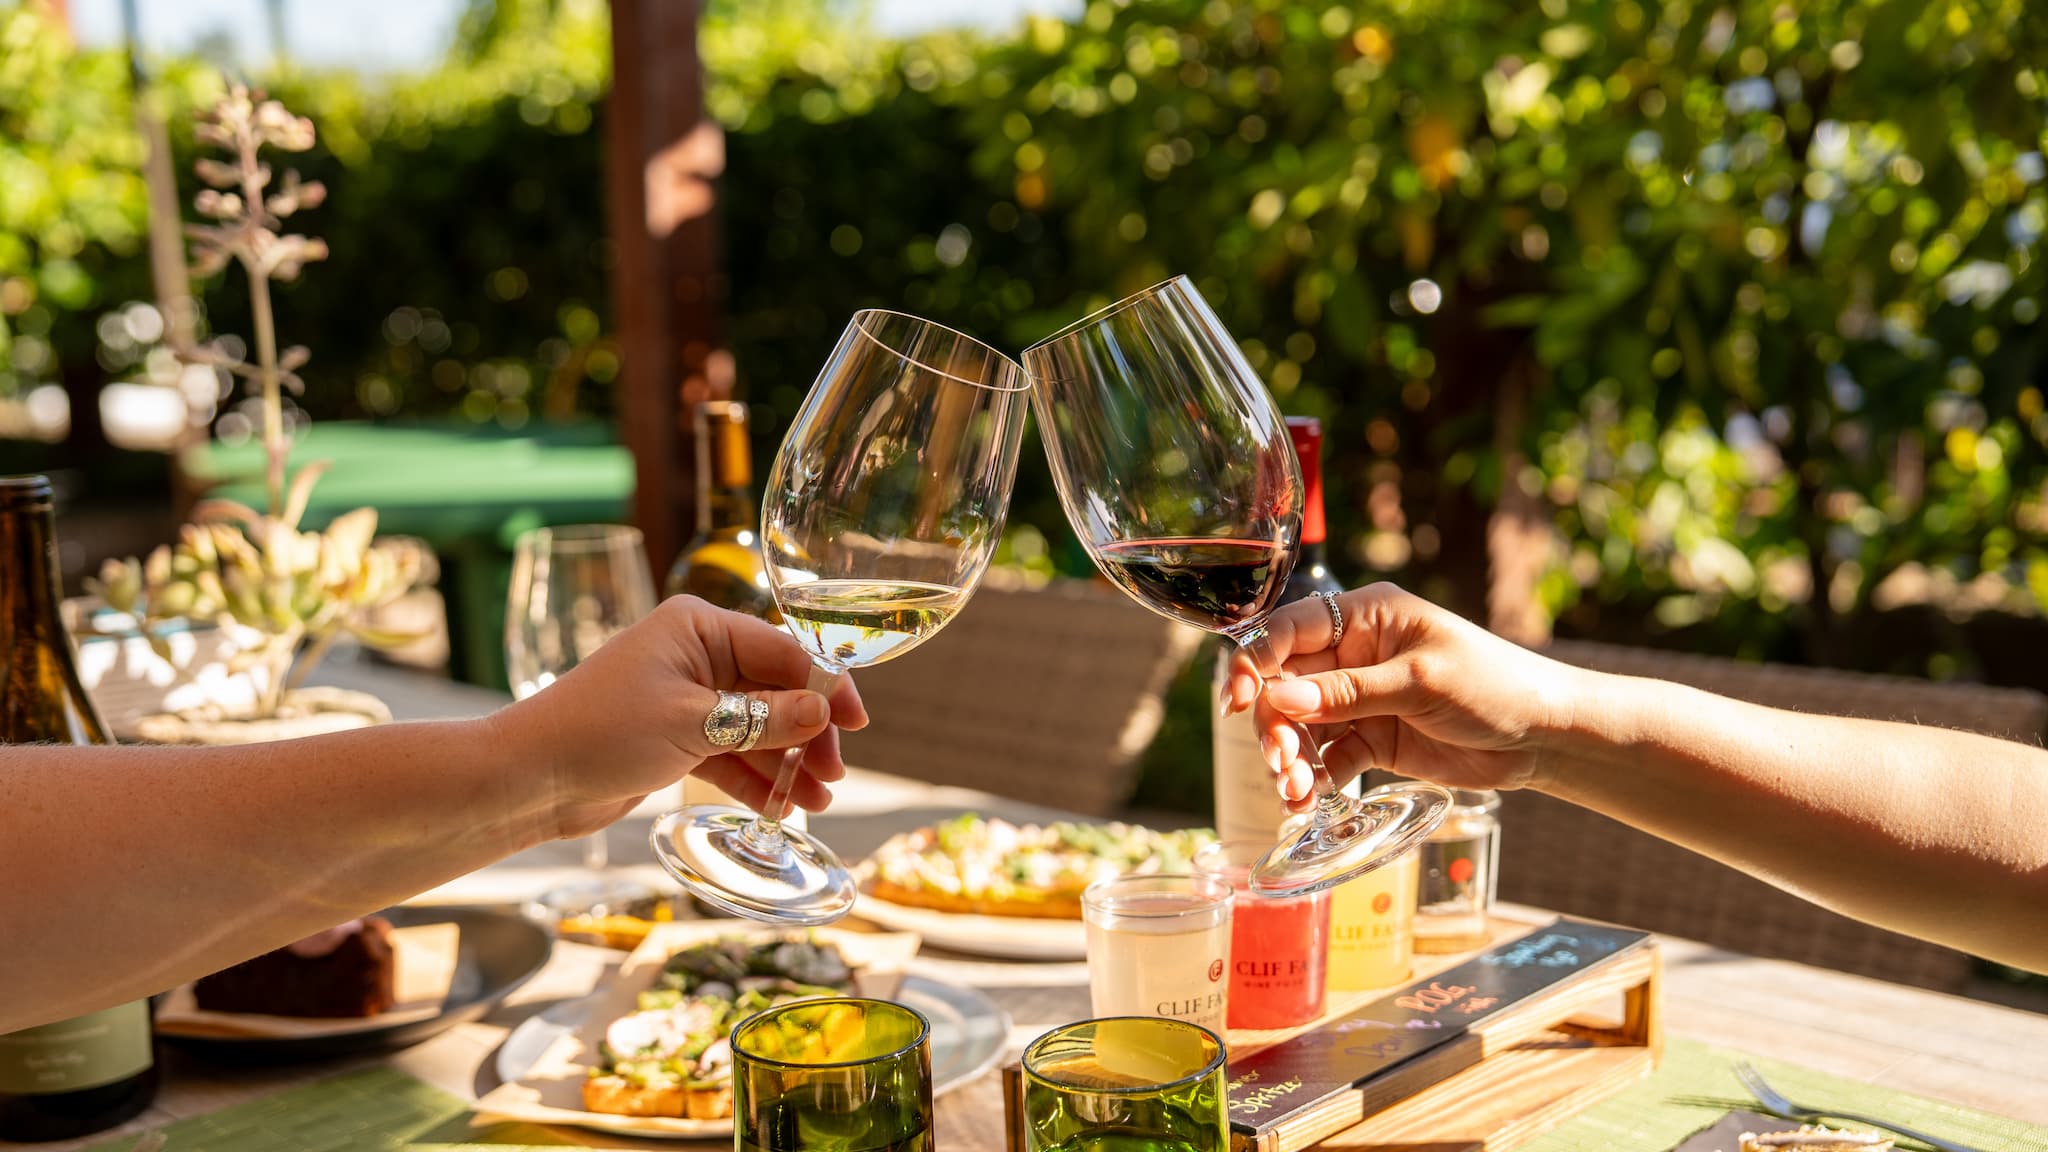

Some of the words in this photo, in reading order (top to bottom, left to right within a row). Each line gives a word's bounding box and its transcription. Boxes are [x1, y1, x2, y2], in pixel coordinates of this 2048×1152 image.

[1334, 924, 1365, 940] LIF
[1236, 961, 1282, 976] CLIF
[1156, 997, 1203, 1017] CLIF
